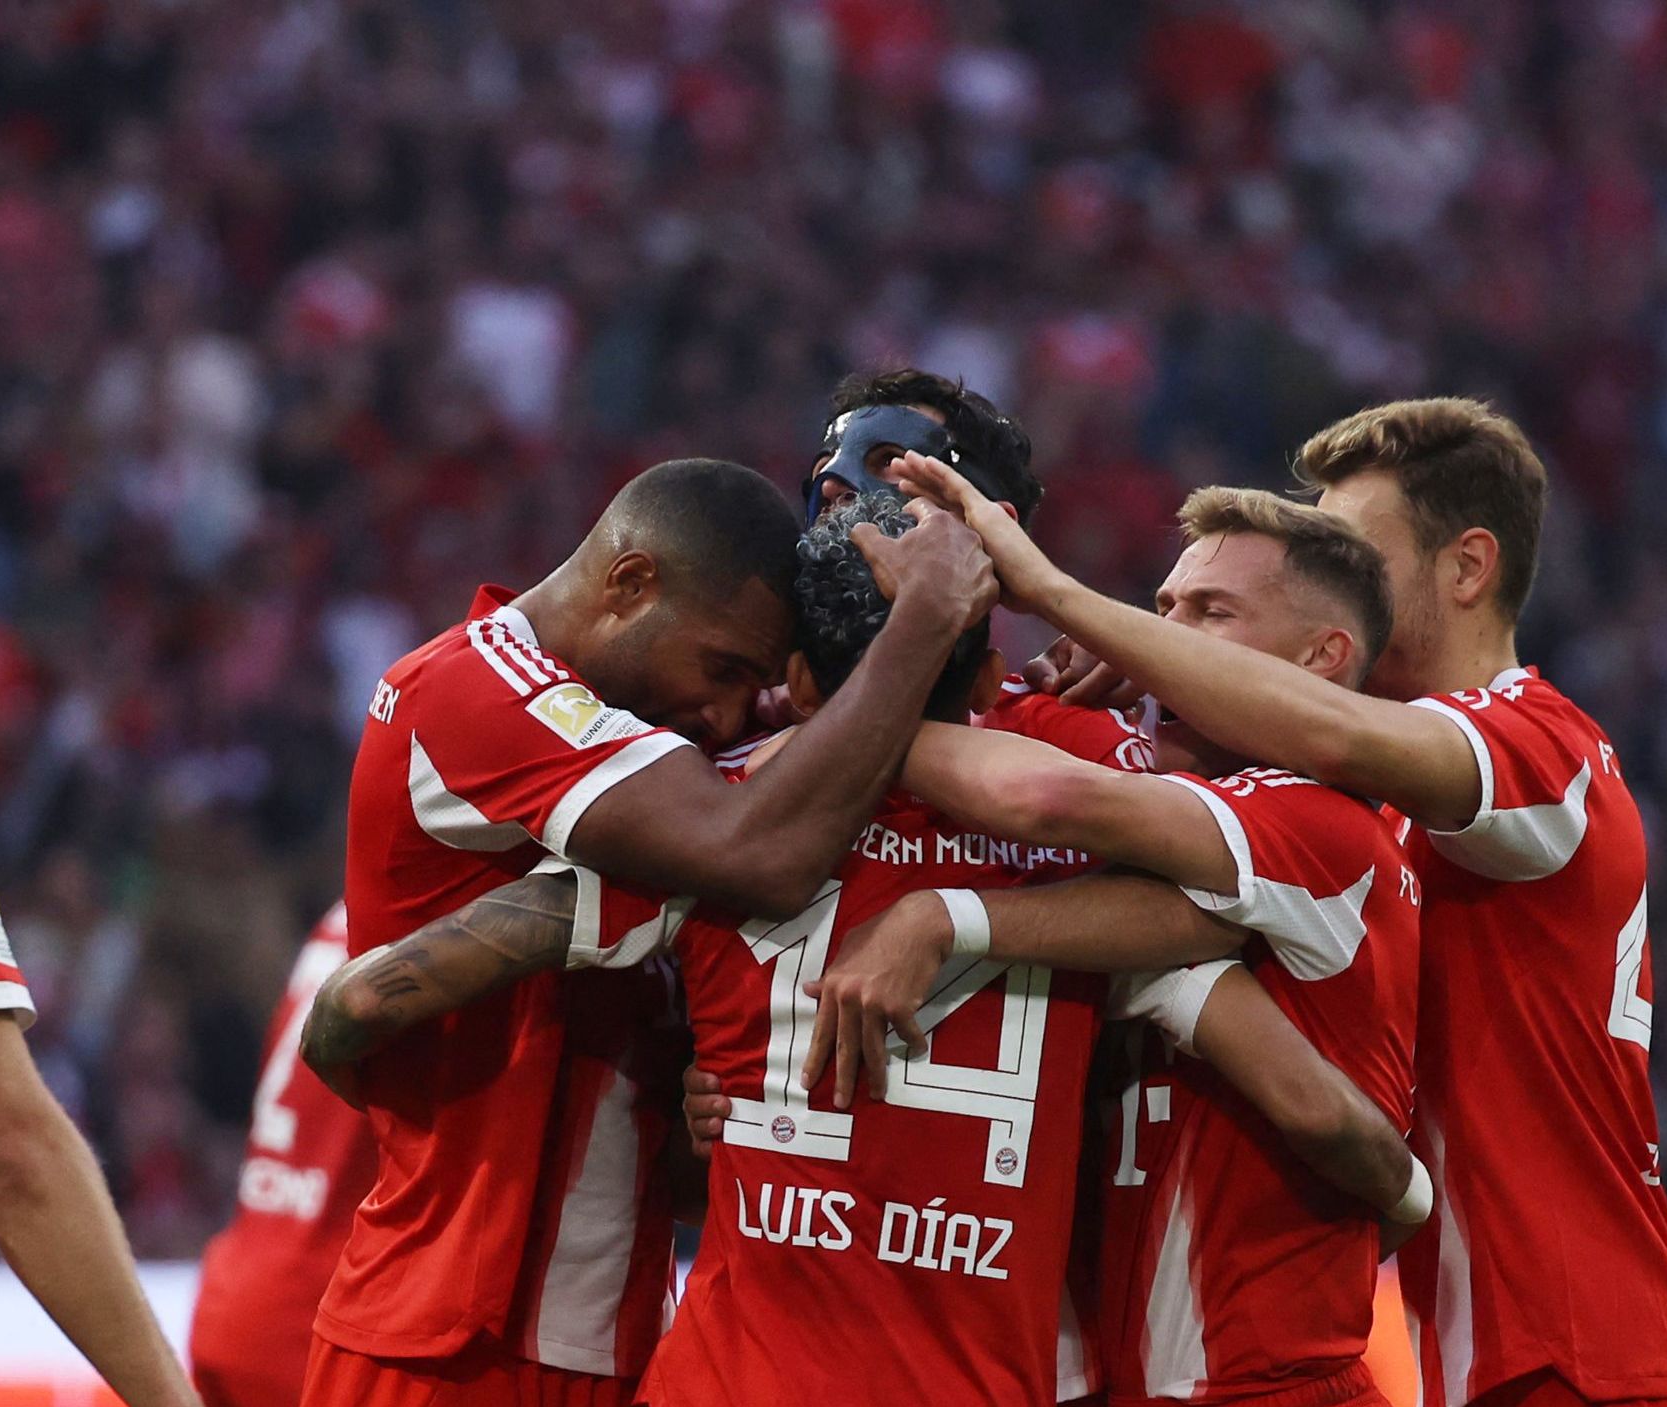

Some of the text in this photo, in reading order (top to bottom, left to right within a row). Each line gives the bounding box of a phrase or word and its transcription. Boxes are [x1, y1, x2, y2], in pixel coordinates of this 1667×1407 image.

[723, 879, 1051, 1189] 14
[735, 1178, 1013, 1280] LUIS DÍAZ
